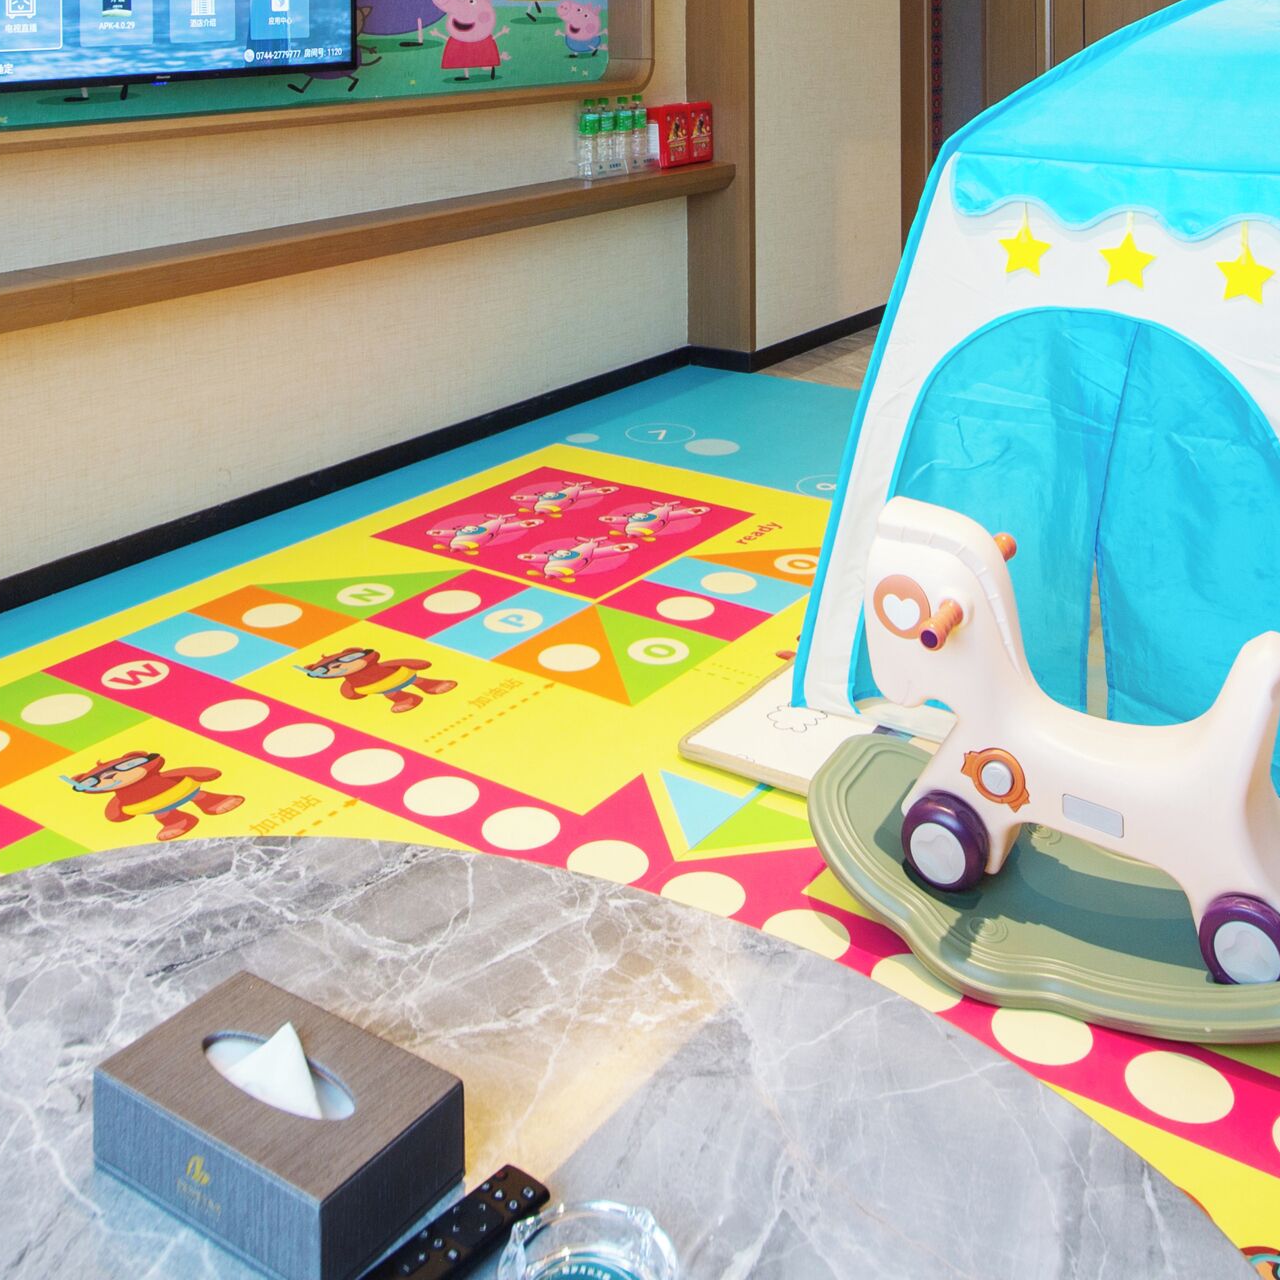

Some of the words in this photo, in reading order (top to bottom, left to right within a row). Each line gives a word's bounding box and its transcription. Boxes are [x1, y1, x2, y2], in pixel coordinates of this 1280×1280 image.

[190, 18, 216, 28] 酒店介绍
[268, 17, 293, 26] 应用中心
[735, 521, 783, 546] ready
[249, 794, 322, 836] 加油站
